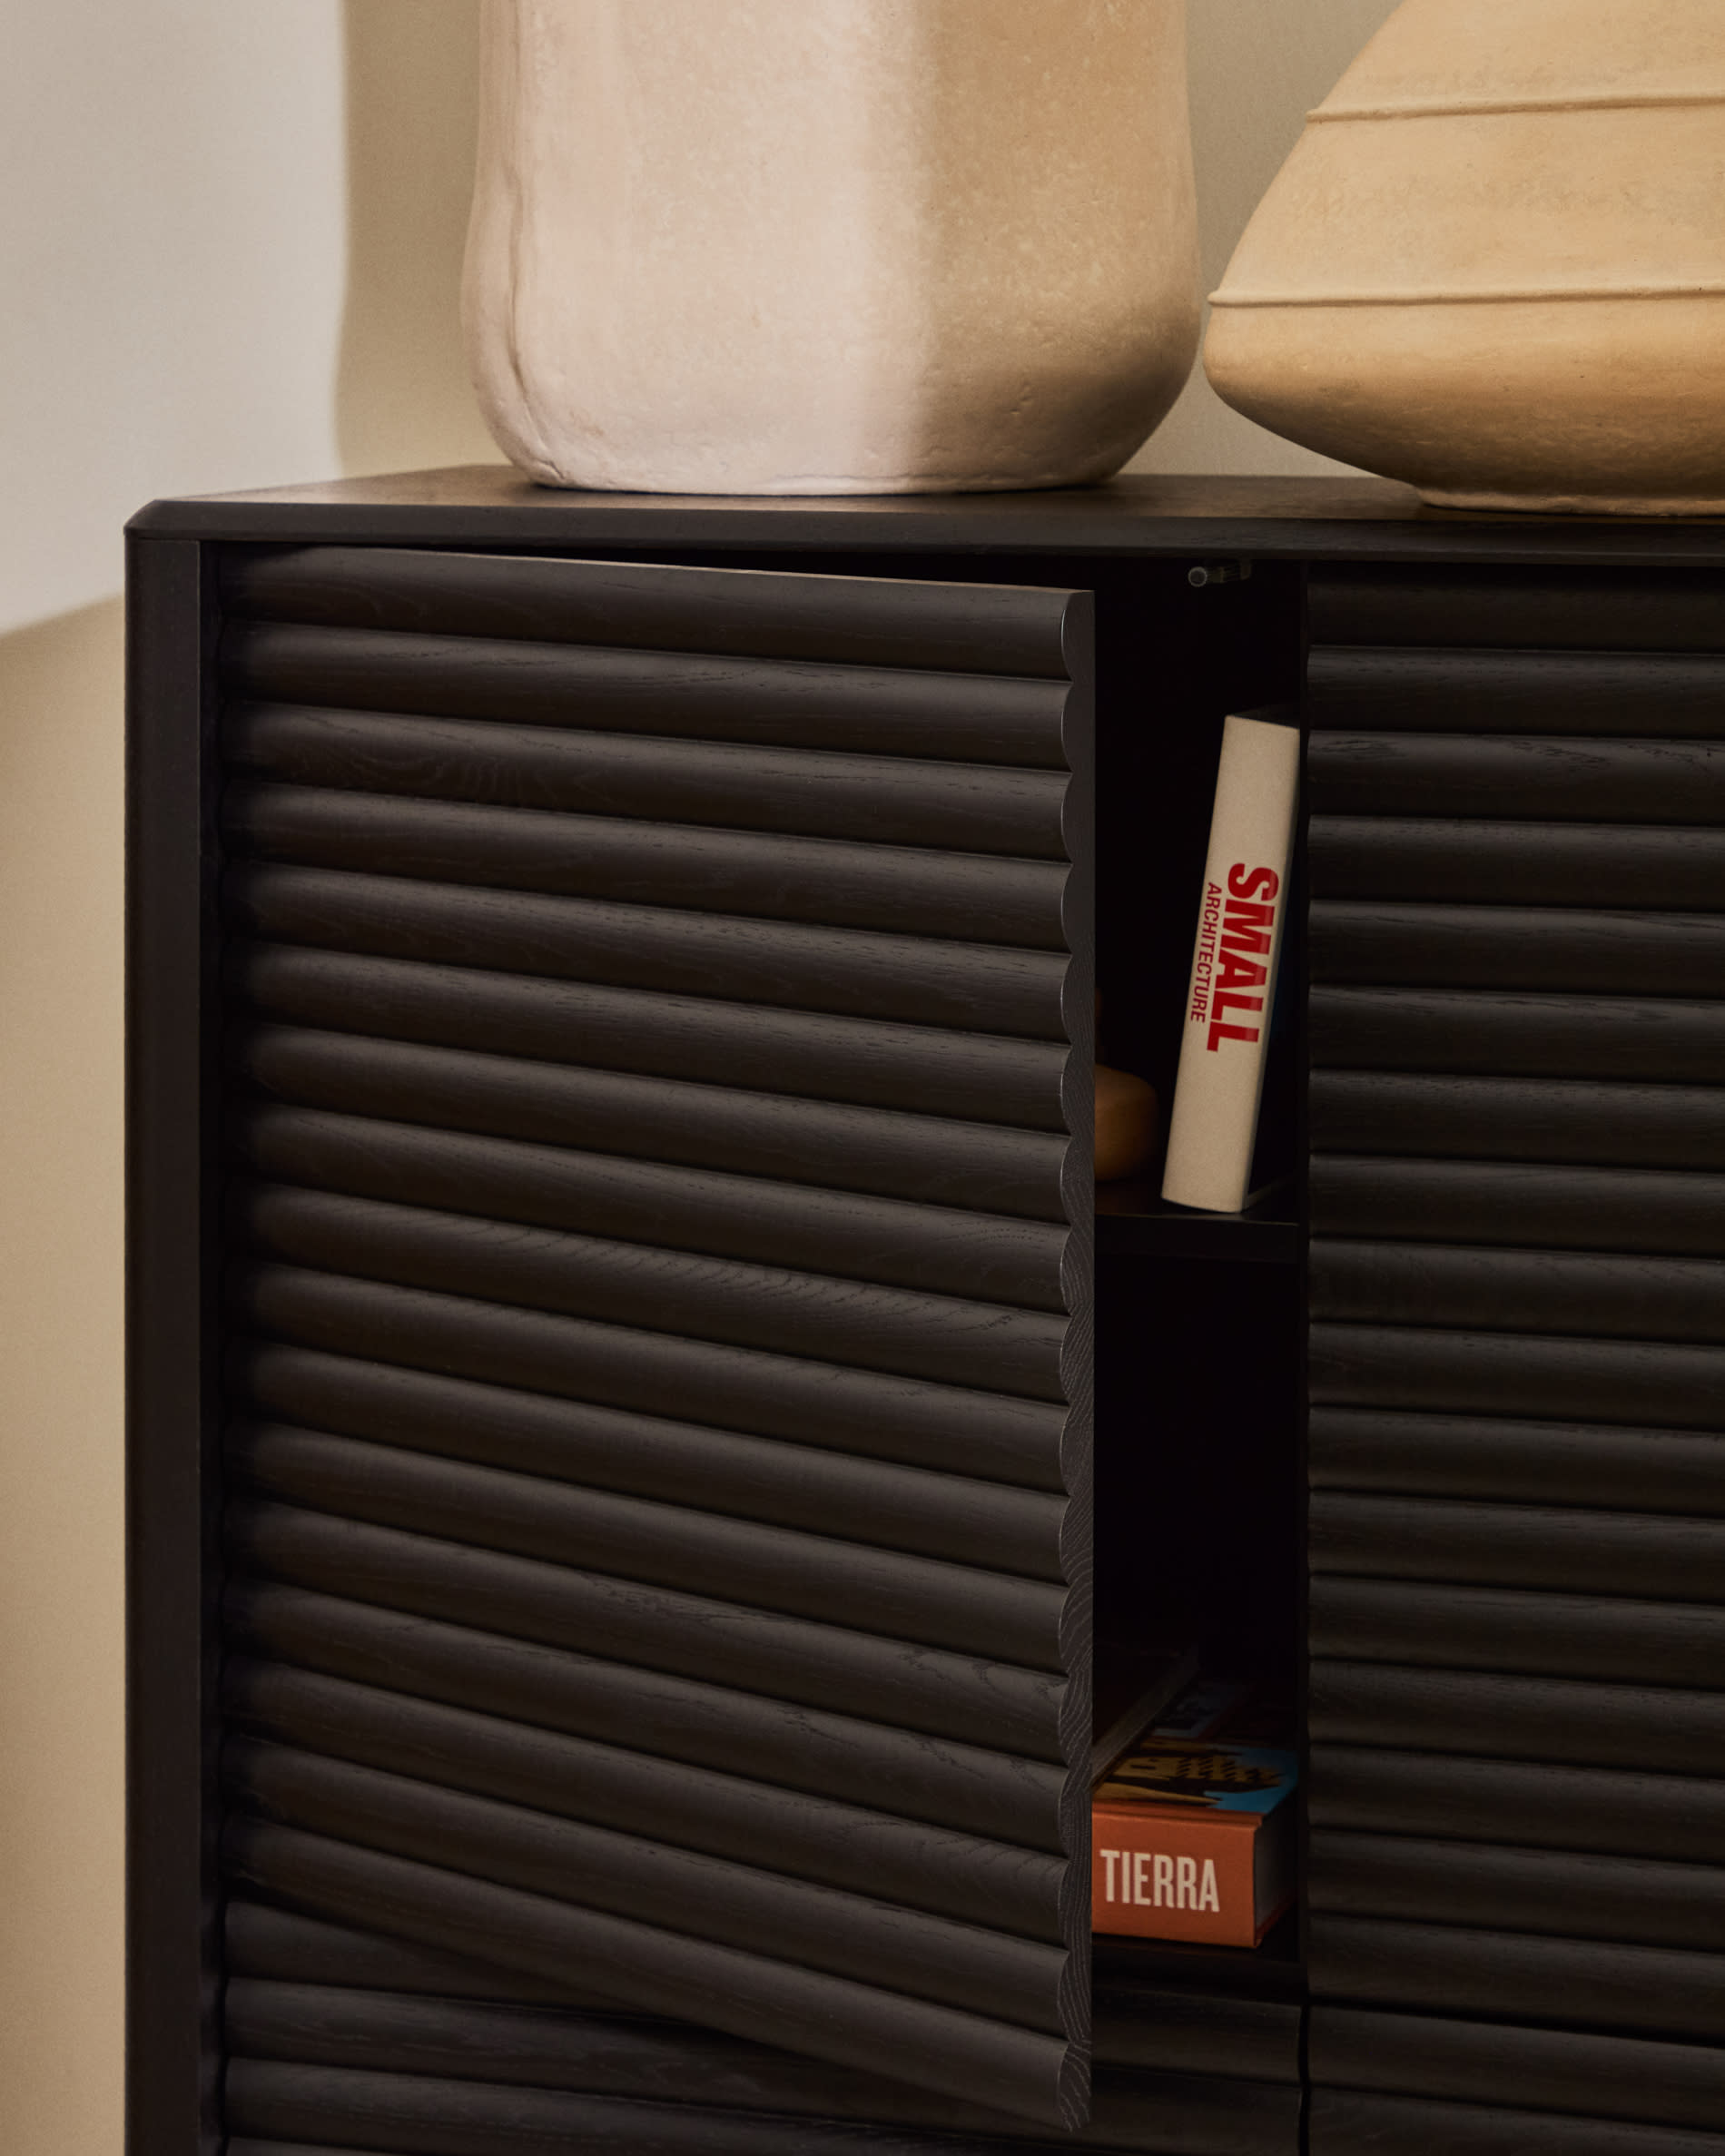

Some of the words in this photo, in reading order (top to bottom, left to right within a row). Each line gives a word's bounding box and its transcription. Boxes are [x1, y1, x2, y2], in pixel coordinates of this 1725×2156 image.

[1190, 882, 1222, 1023] ARCHITECTURE
[1208, 863, 1279, 1051] SMALL
[1099, 1848, 1220, 1912] TIERRA
